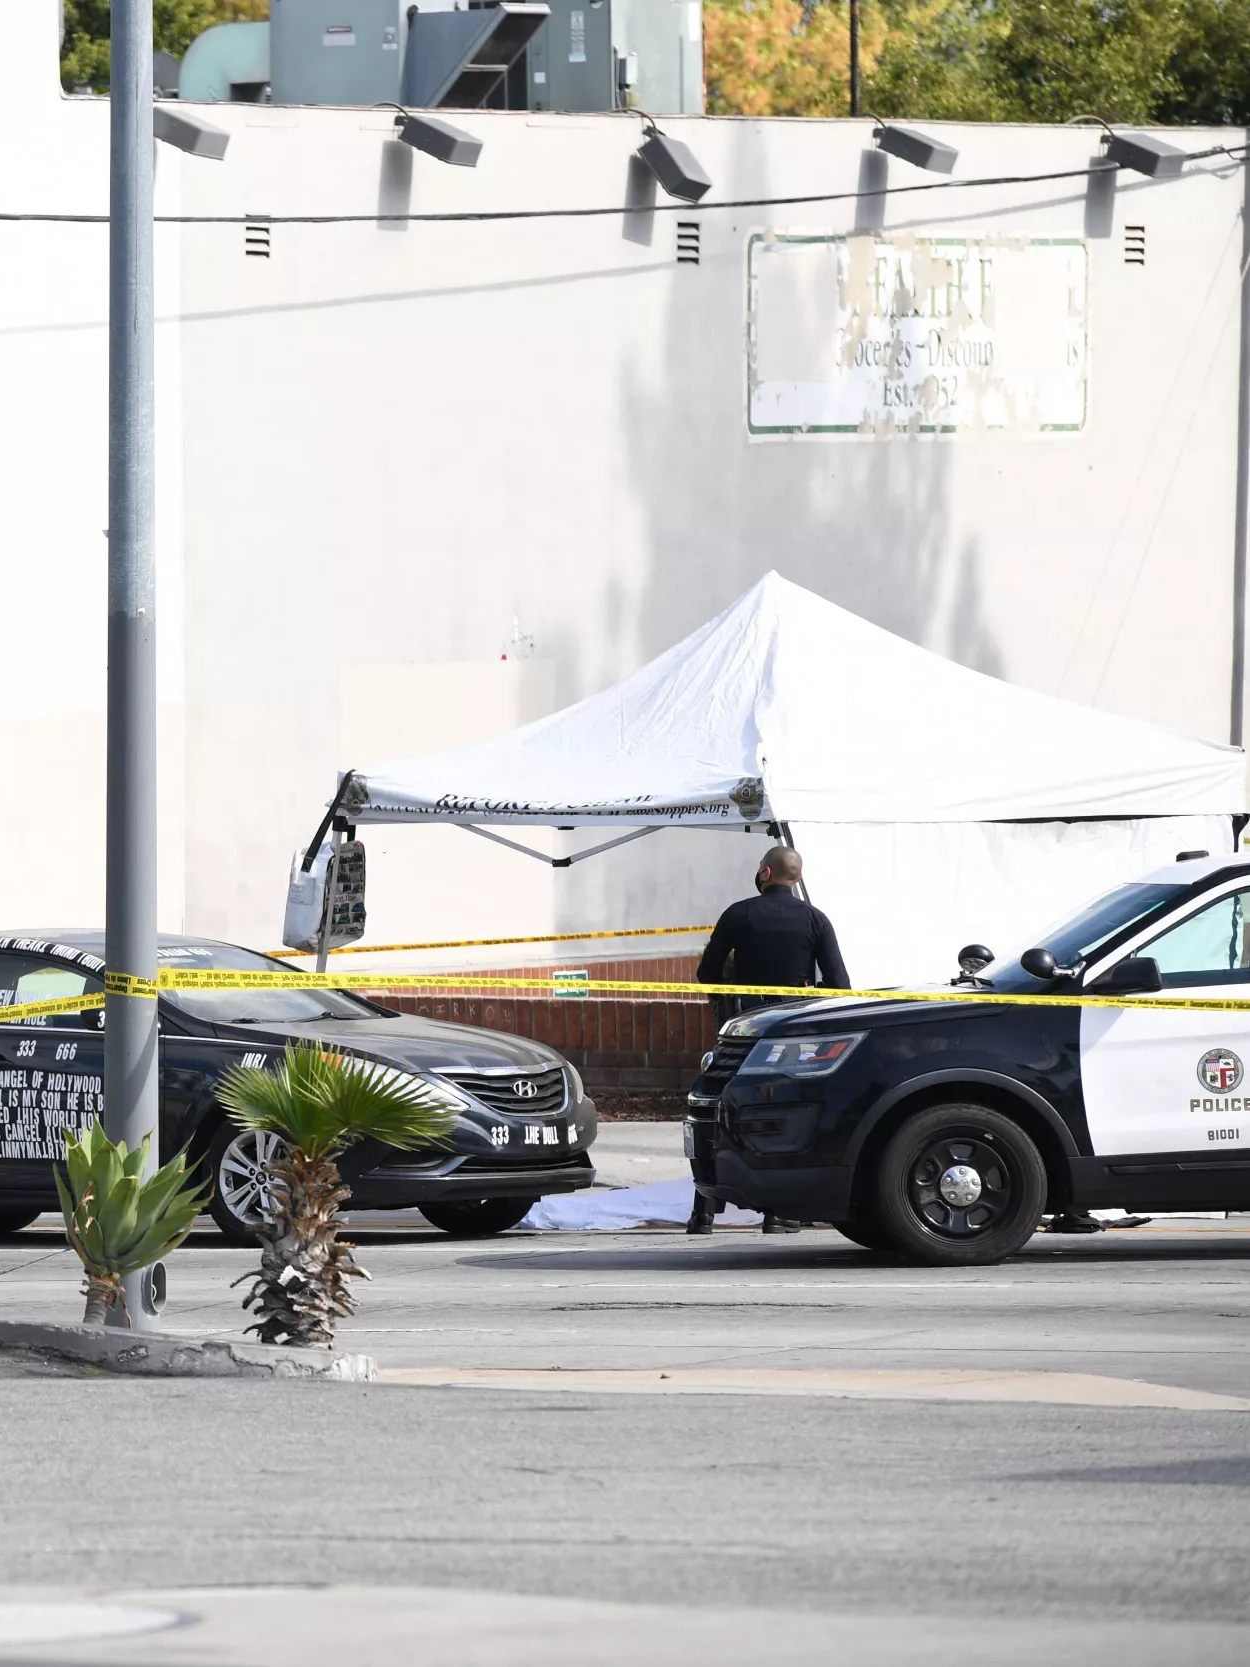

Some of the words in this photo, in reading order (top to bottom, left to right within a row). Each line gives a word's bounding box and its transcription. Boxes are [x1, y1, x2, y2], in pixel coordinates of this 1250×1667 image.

[16, 1040, 37, 1057] 333
[55, 1043, 78, 1061] 666
[240, 1052, 268, 1069] INRI
[32, 1070, 44, 1089] OF
[47, 1072, 102, 1094] HOLYWOOD
[8, 1089, 19, 1108] IS
[22, 1089, 37, 1108] MY
[41, 1090, 61, 1109] SON
[67, 1092, 79, 1111] HE
[84, 1093, 94, 1112] IS
[1189, 1098, 1250, 1113] POLICE
[16, 1107, 40, 1126] THIS
[43, 1109, 77, 1129] WORLD
[4, 1123, 42, 1143] CANCEL
[46, 1125, 65, 1145] ALL
[491, 1125, 510, 1146] 333
[524, 1125, 540, 1145] THE
